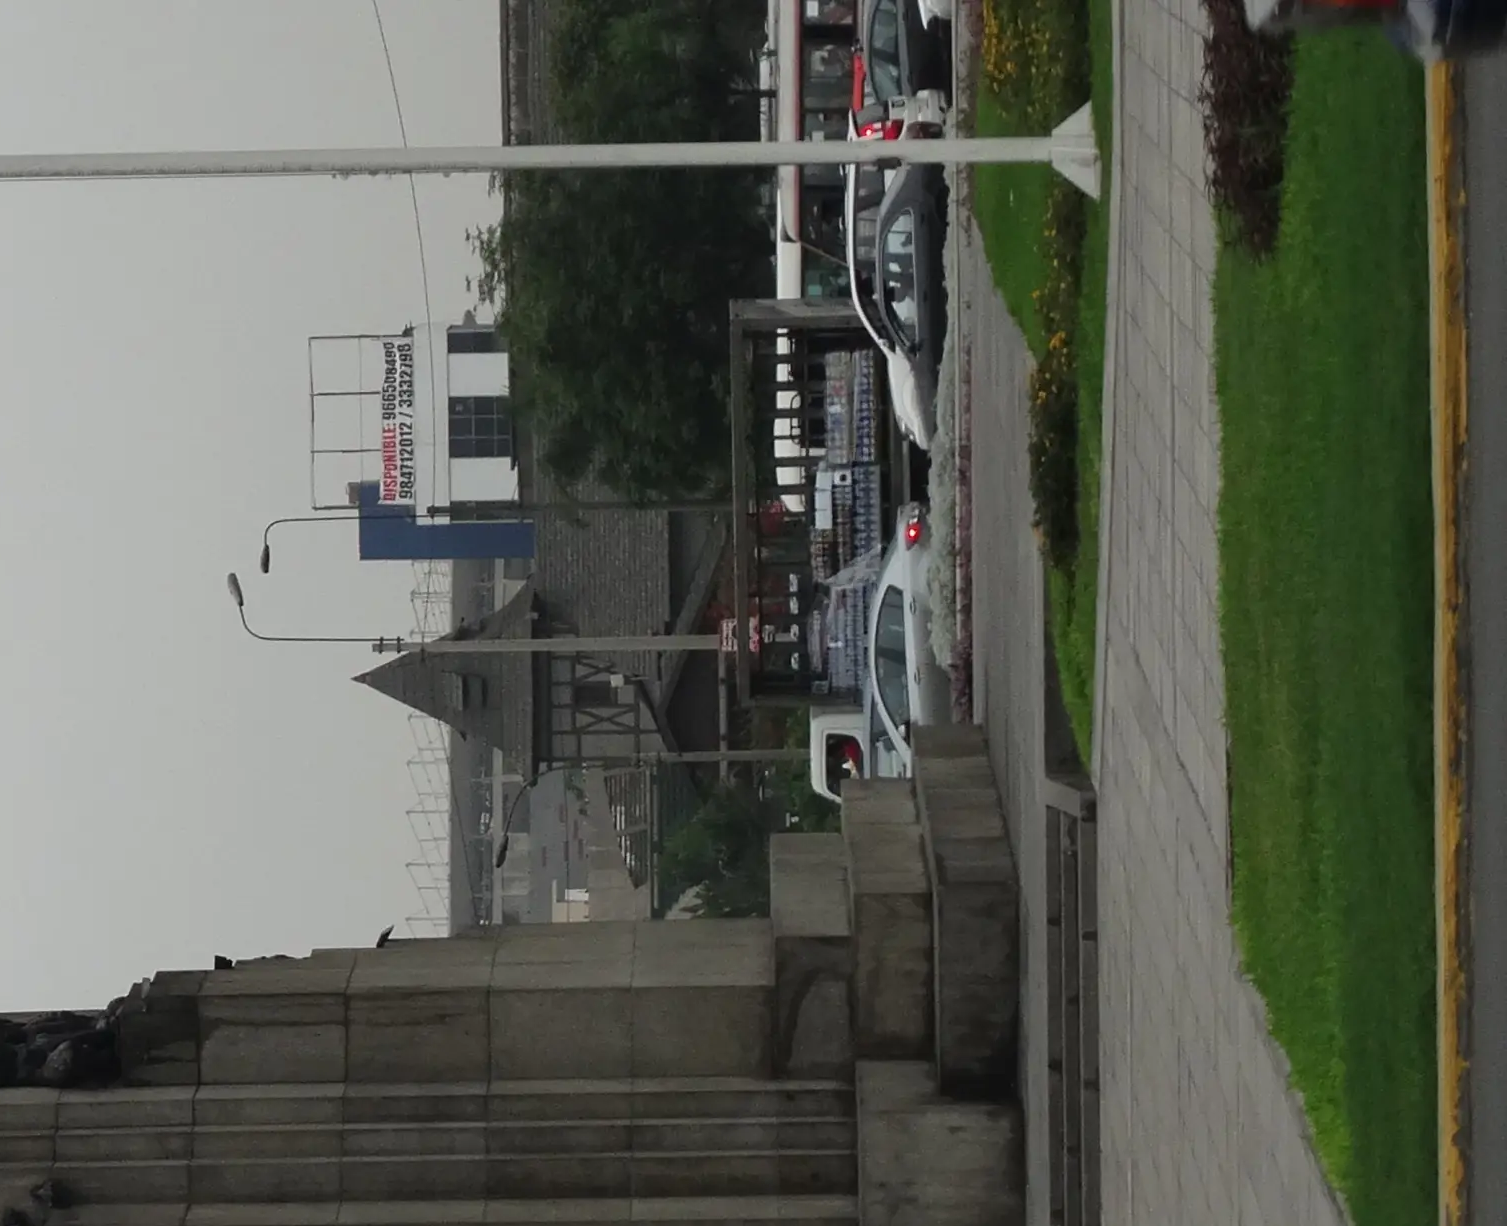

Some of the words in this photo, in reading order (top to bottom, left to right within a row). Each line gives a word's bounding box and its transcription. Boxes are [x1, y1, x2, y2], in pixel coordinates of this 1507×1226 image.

[397, 343, 414, 408] 3332798
[382, 423, 398, 501] DISPONIBLE:
[398, 422, 414, 499] 984712012
